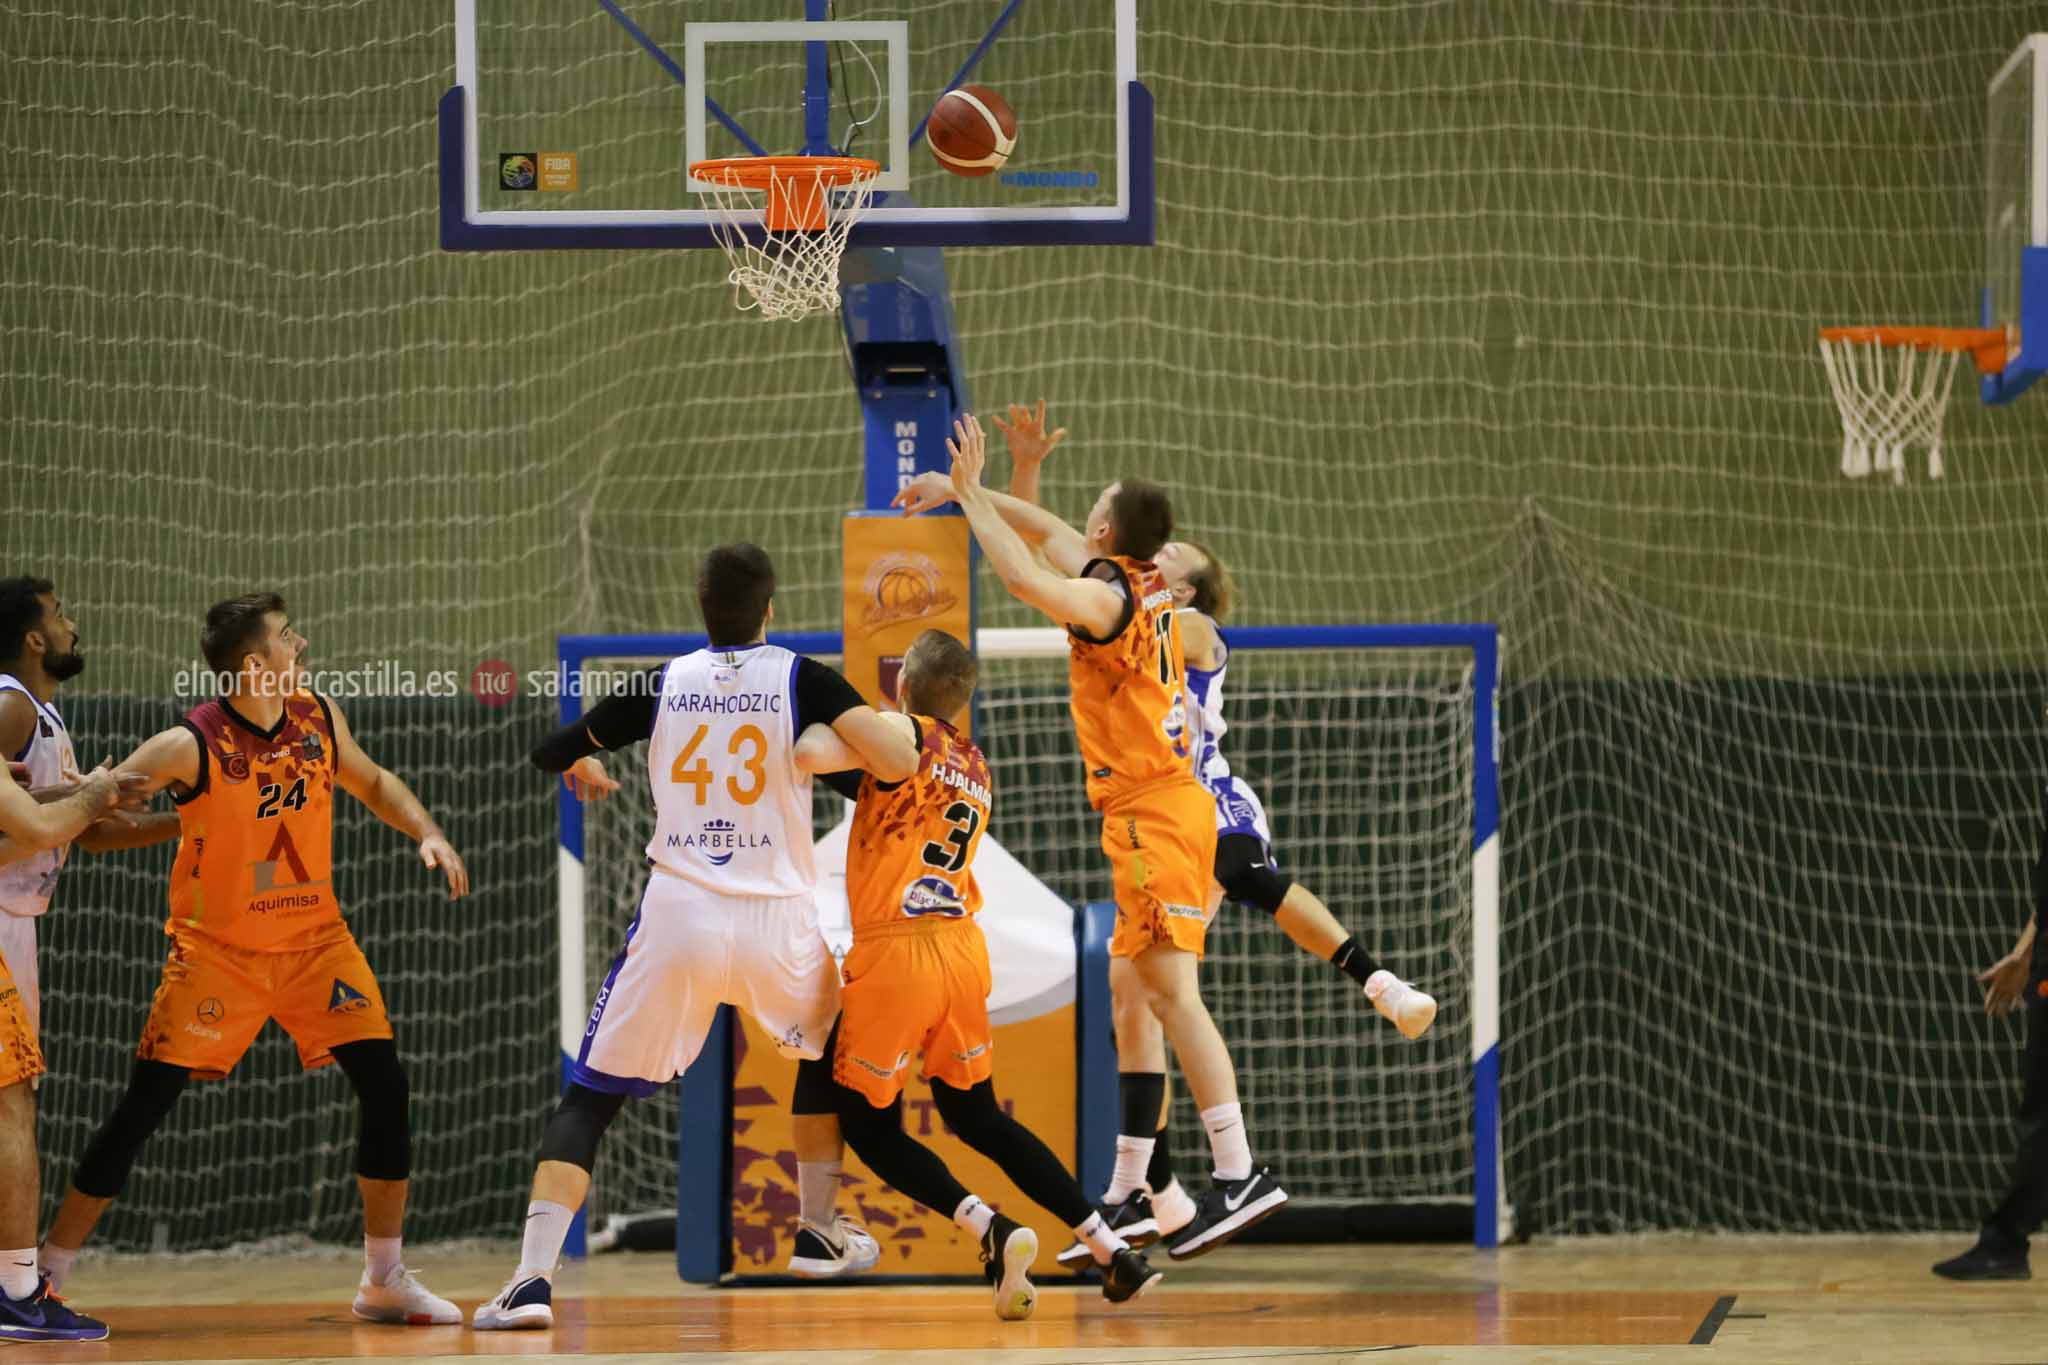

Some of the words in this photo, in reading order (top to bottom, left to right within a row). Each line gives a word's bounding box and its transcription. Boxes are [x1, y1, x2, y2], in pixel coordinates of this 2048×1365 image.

[894, 421, 918, 508] MOND
[667, 693, 781, 714] KARAHODZIC
[671, 724, 768, 806] 43
[255, 777, 309, 820] 24
[667, 833, 773, 848] MARBELLA
[921, 799, 981, 875] 3
[248, 893, 320, 913] Aquimisa
[586, 986, 610, 1037] CBM
